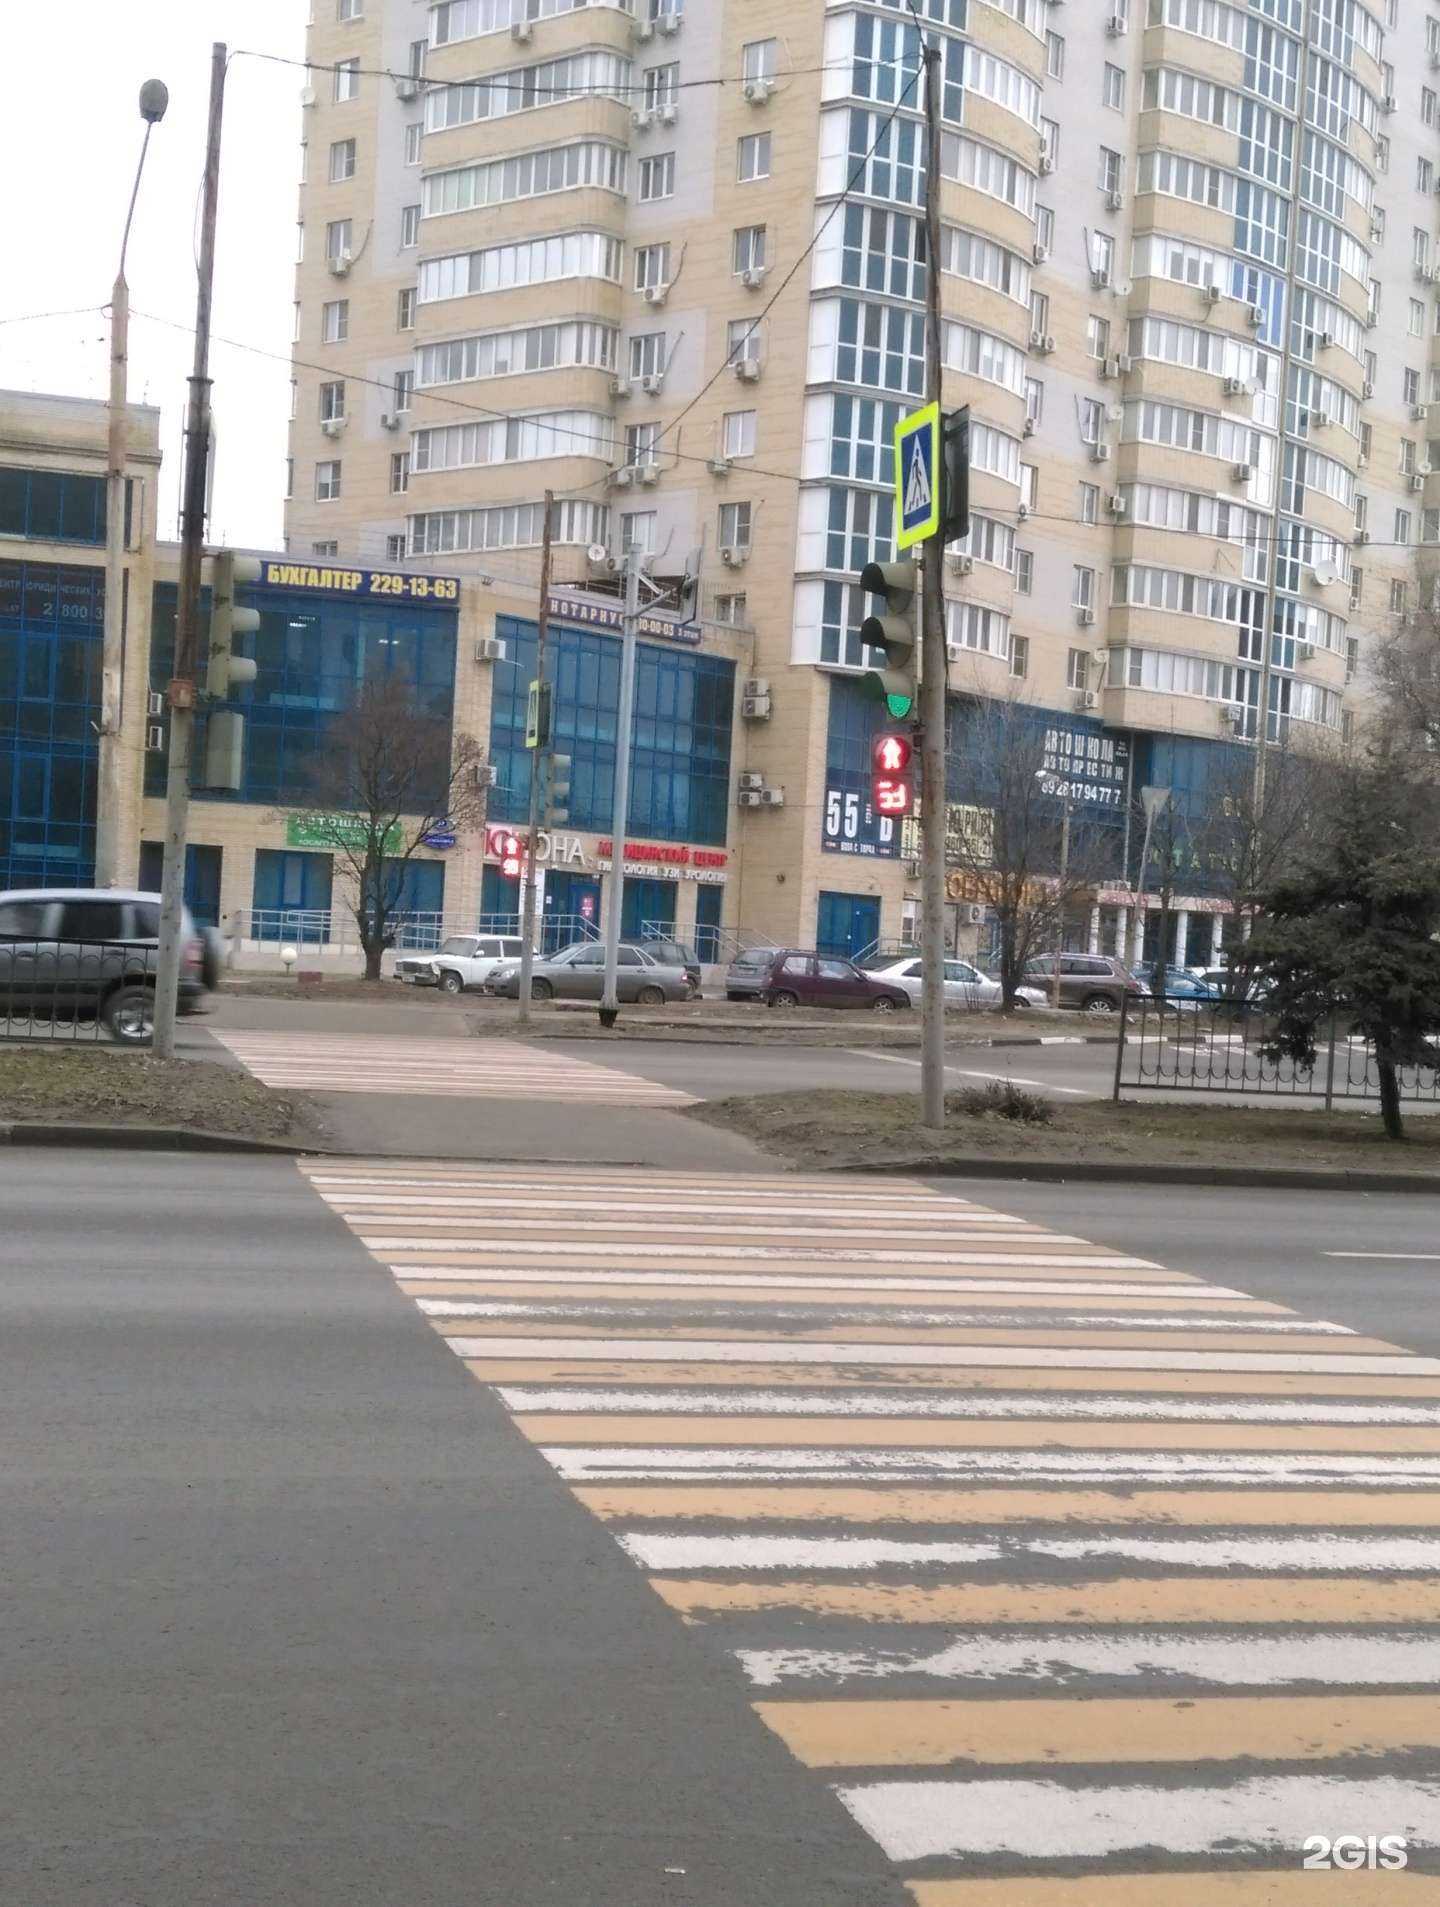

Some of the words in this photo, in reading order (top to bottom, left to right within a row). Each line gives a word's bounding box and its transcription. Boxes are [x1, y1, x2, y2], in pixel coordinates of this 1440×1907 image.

[267, 564, 363, 591] БУХГАЛТЕР
[370, 574, 457, 599] 229-13-63
[1044, 729, 1114, 763] АВТОШКОЛА
